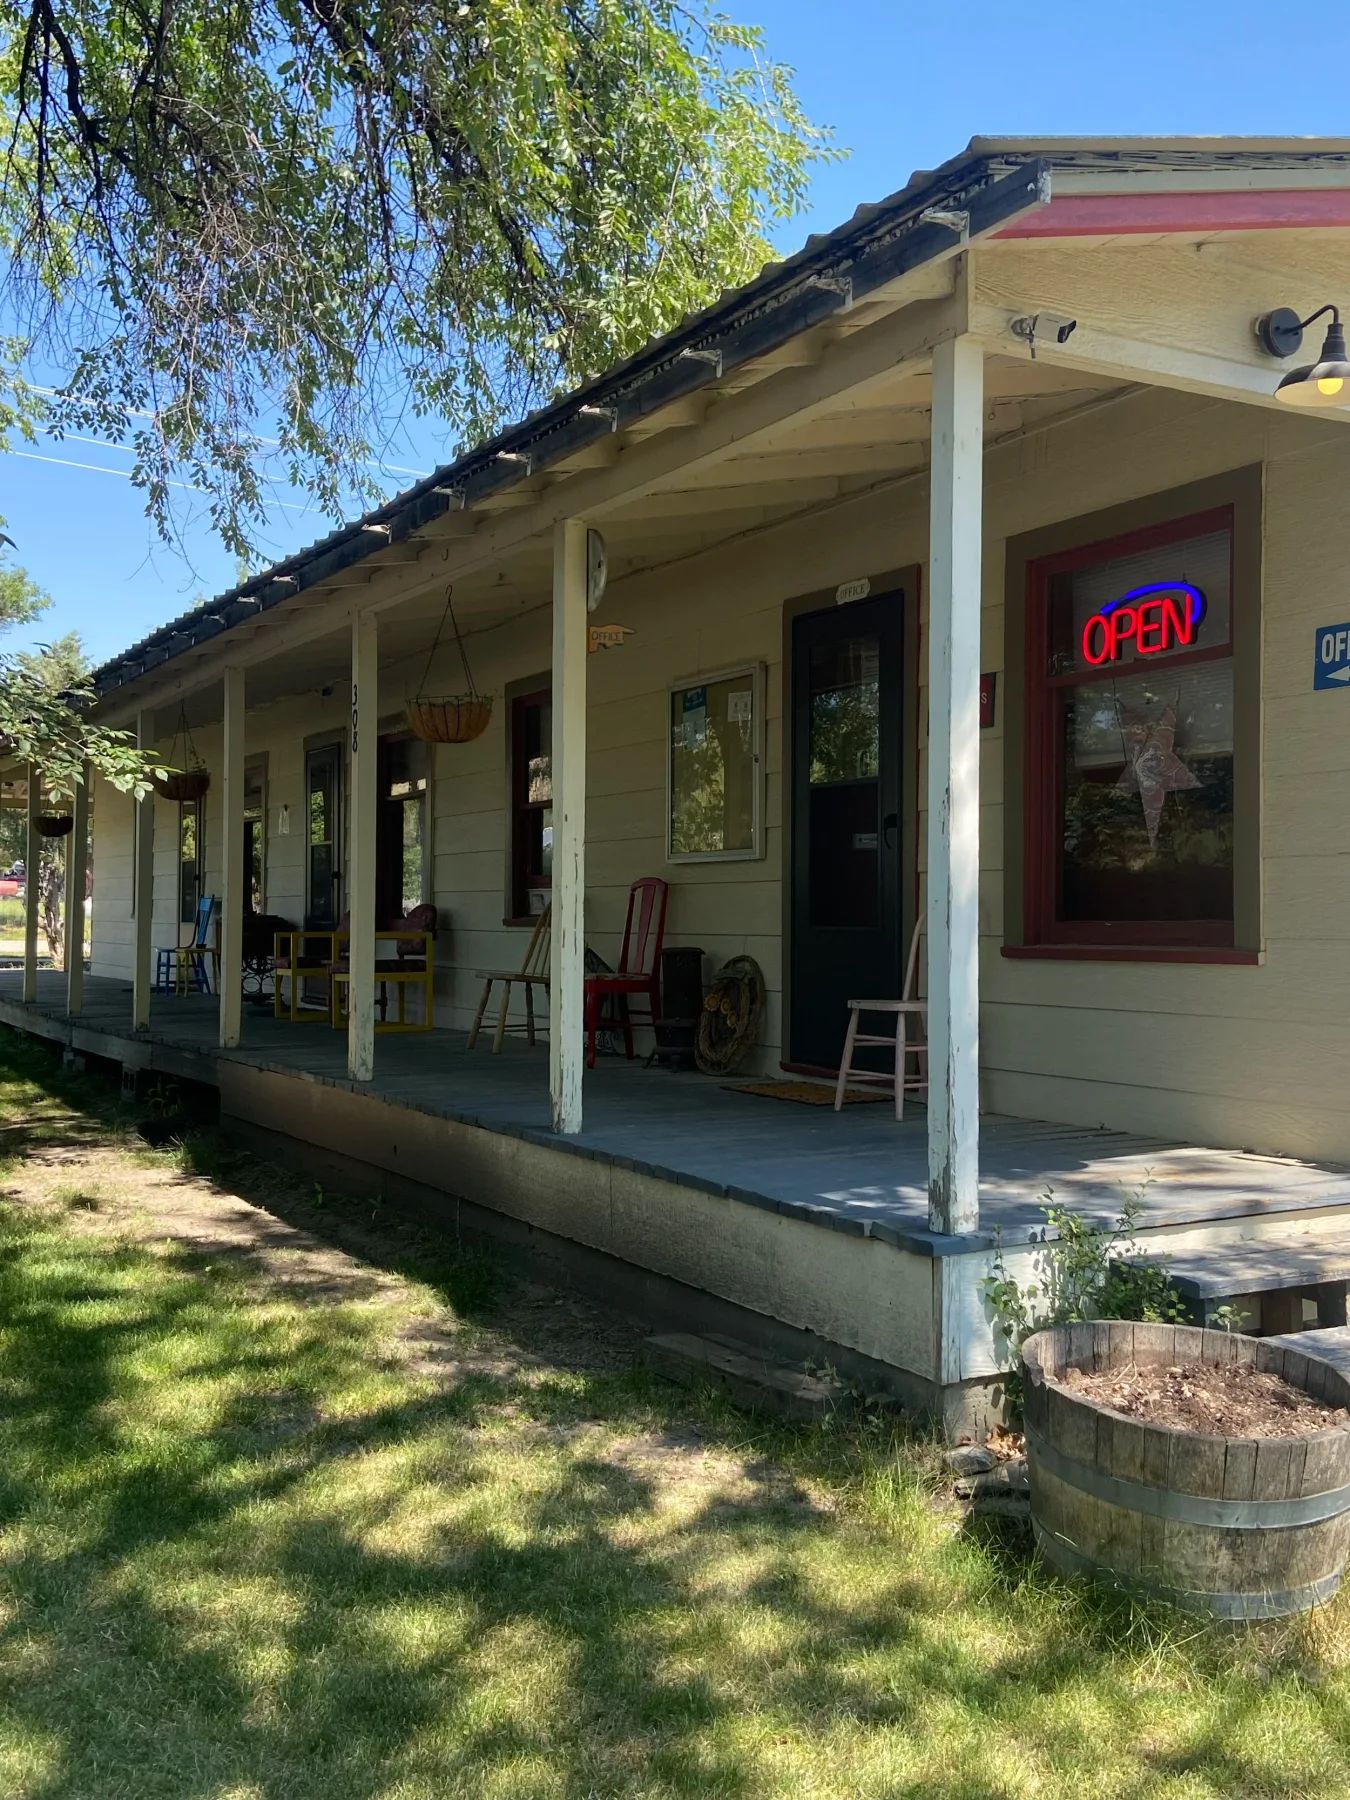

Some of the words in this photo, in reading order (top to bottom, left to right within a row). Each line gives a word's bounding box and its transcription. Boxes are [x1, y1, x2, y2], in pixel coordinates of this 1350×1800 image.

[841, 583, 865, 600] OFFICE
[591, 631, 623, 642] OFFICE
[1082, 593, 1191, 665] OPEN
[1321, 630, 1350, 664] OF
